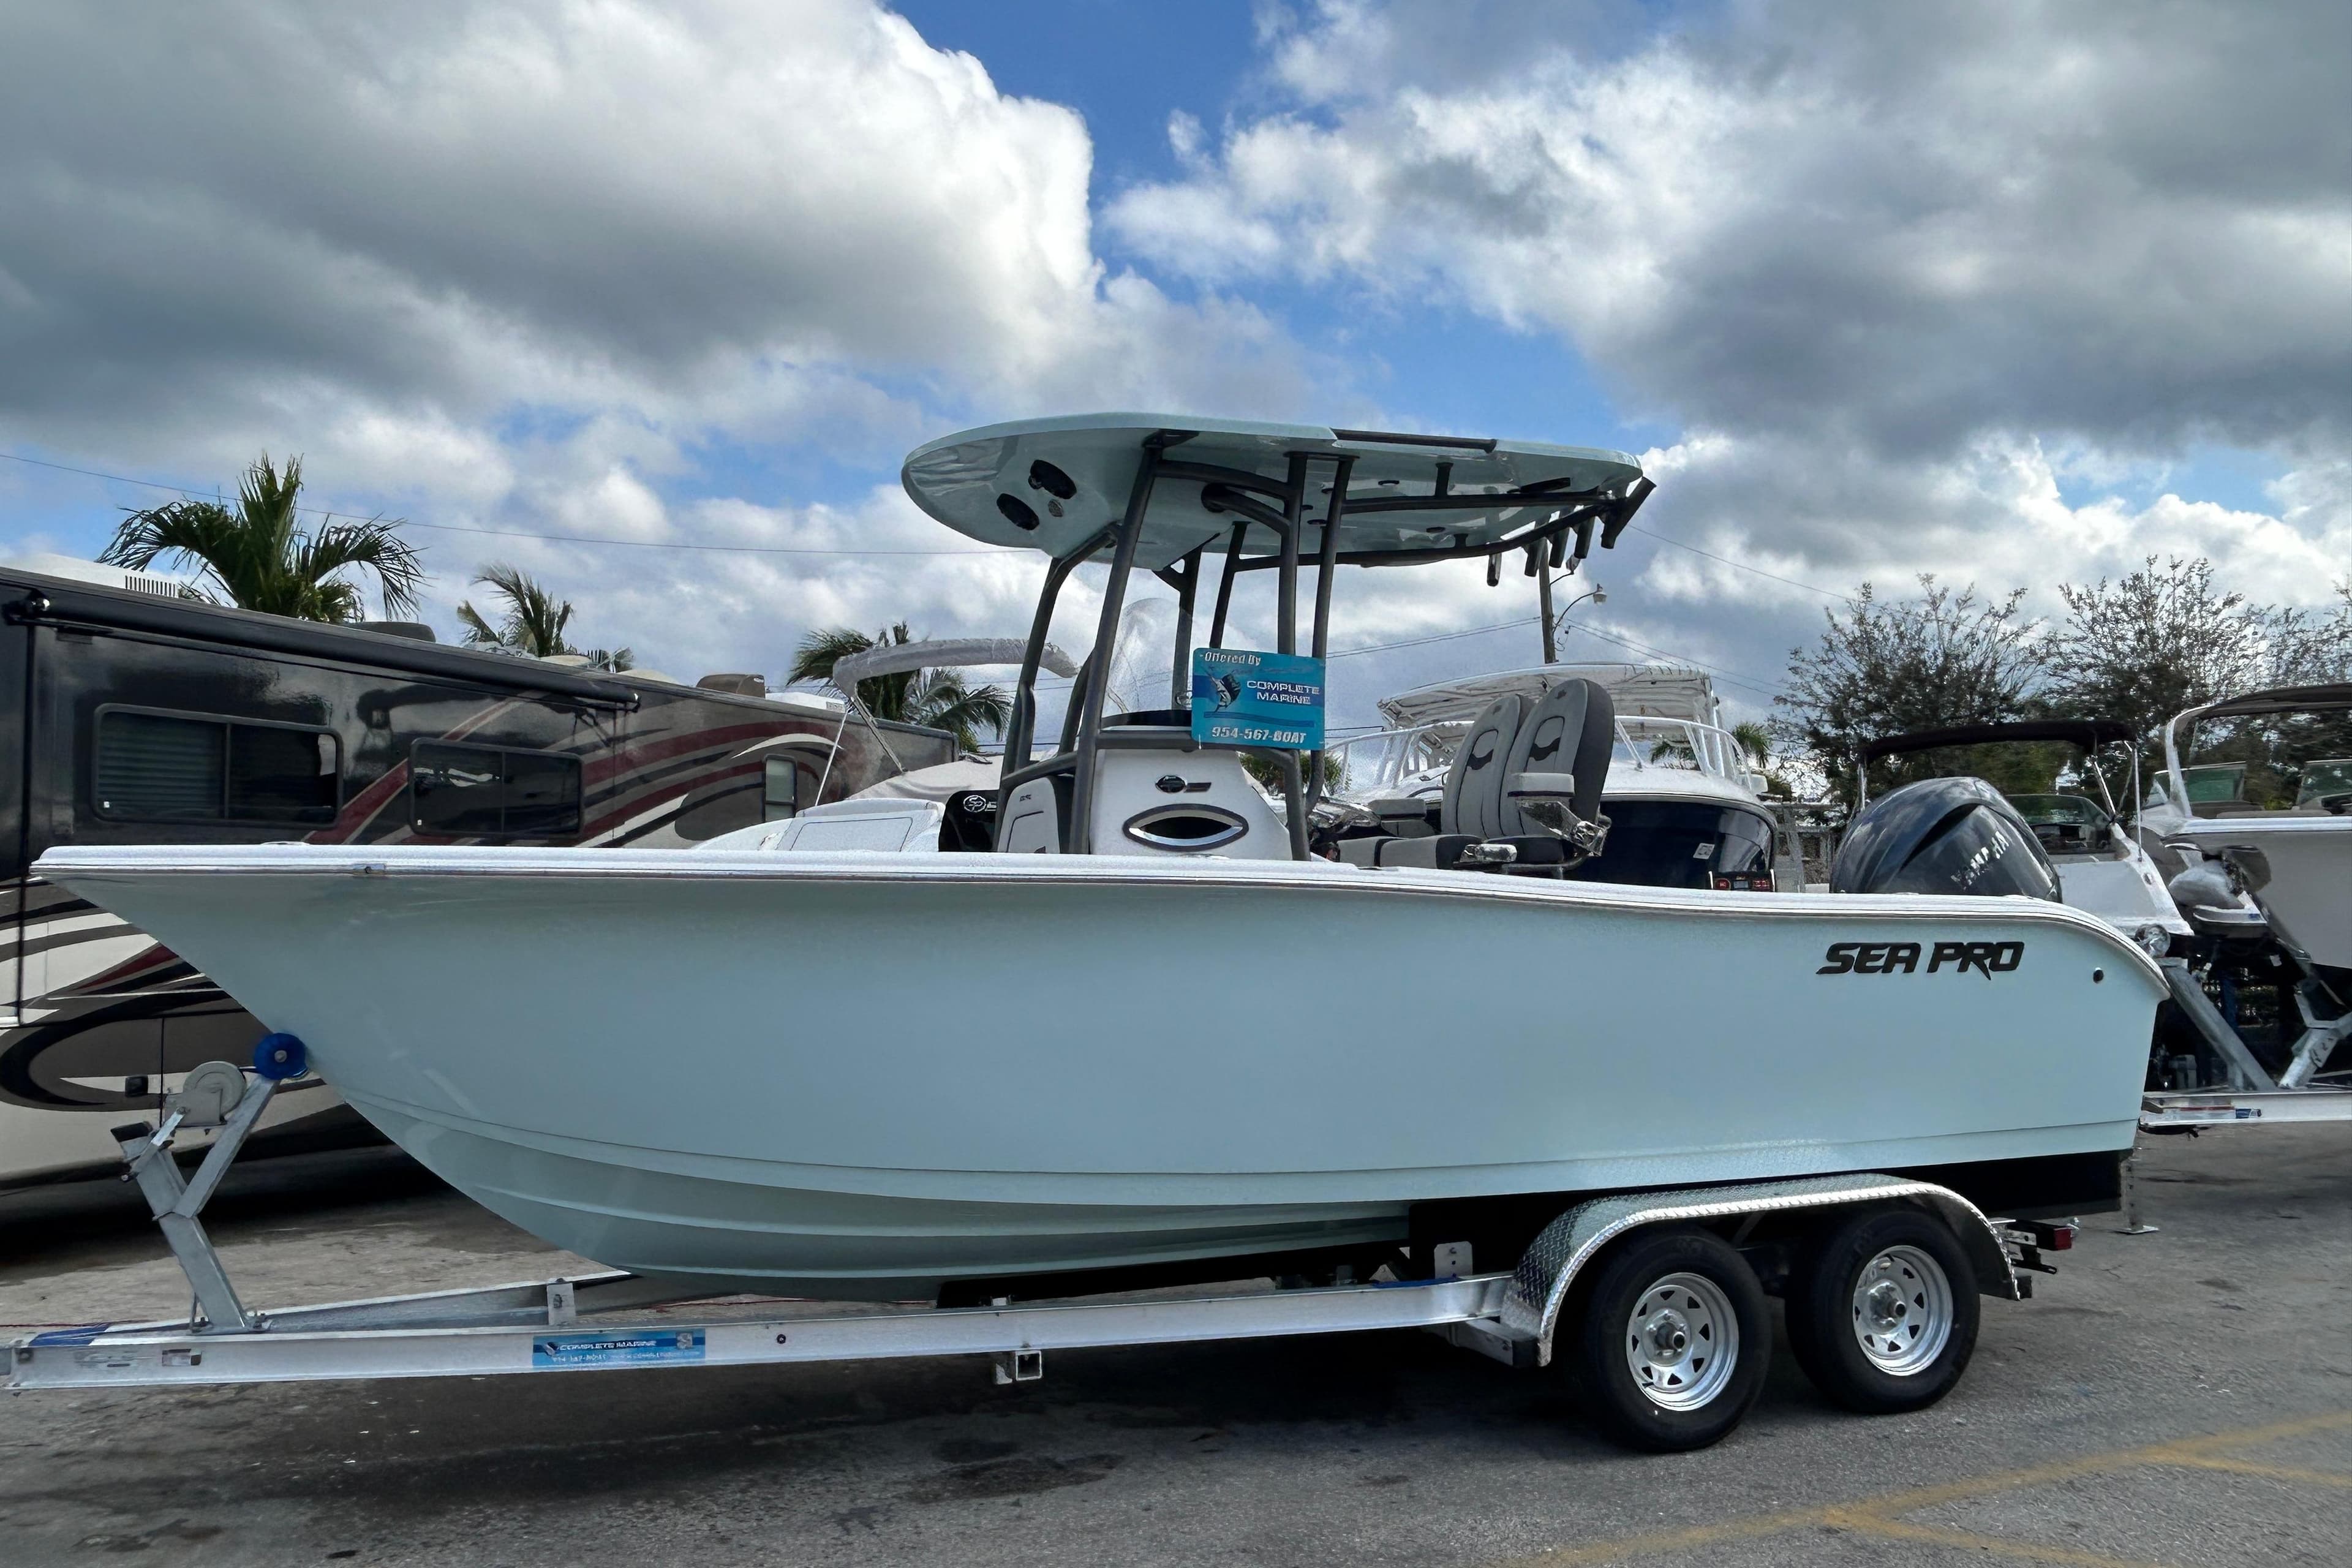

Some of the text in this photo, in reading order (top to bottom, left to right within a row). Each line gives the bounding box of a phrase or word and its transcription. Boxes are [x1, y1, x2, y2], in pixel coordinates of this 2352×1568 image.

[1247, 654, 1262, 666] By
[1247, 680, 1320, 695] COMPLETE
[1257, 692, 1311, 705] MARINE
[1212, 726, 1307, 744] 954-567-BOAT
[1815, 941, 2024, 981] SEA PRO
